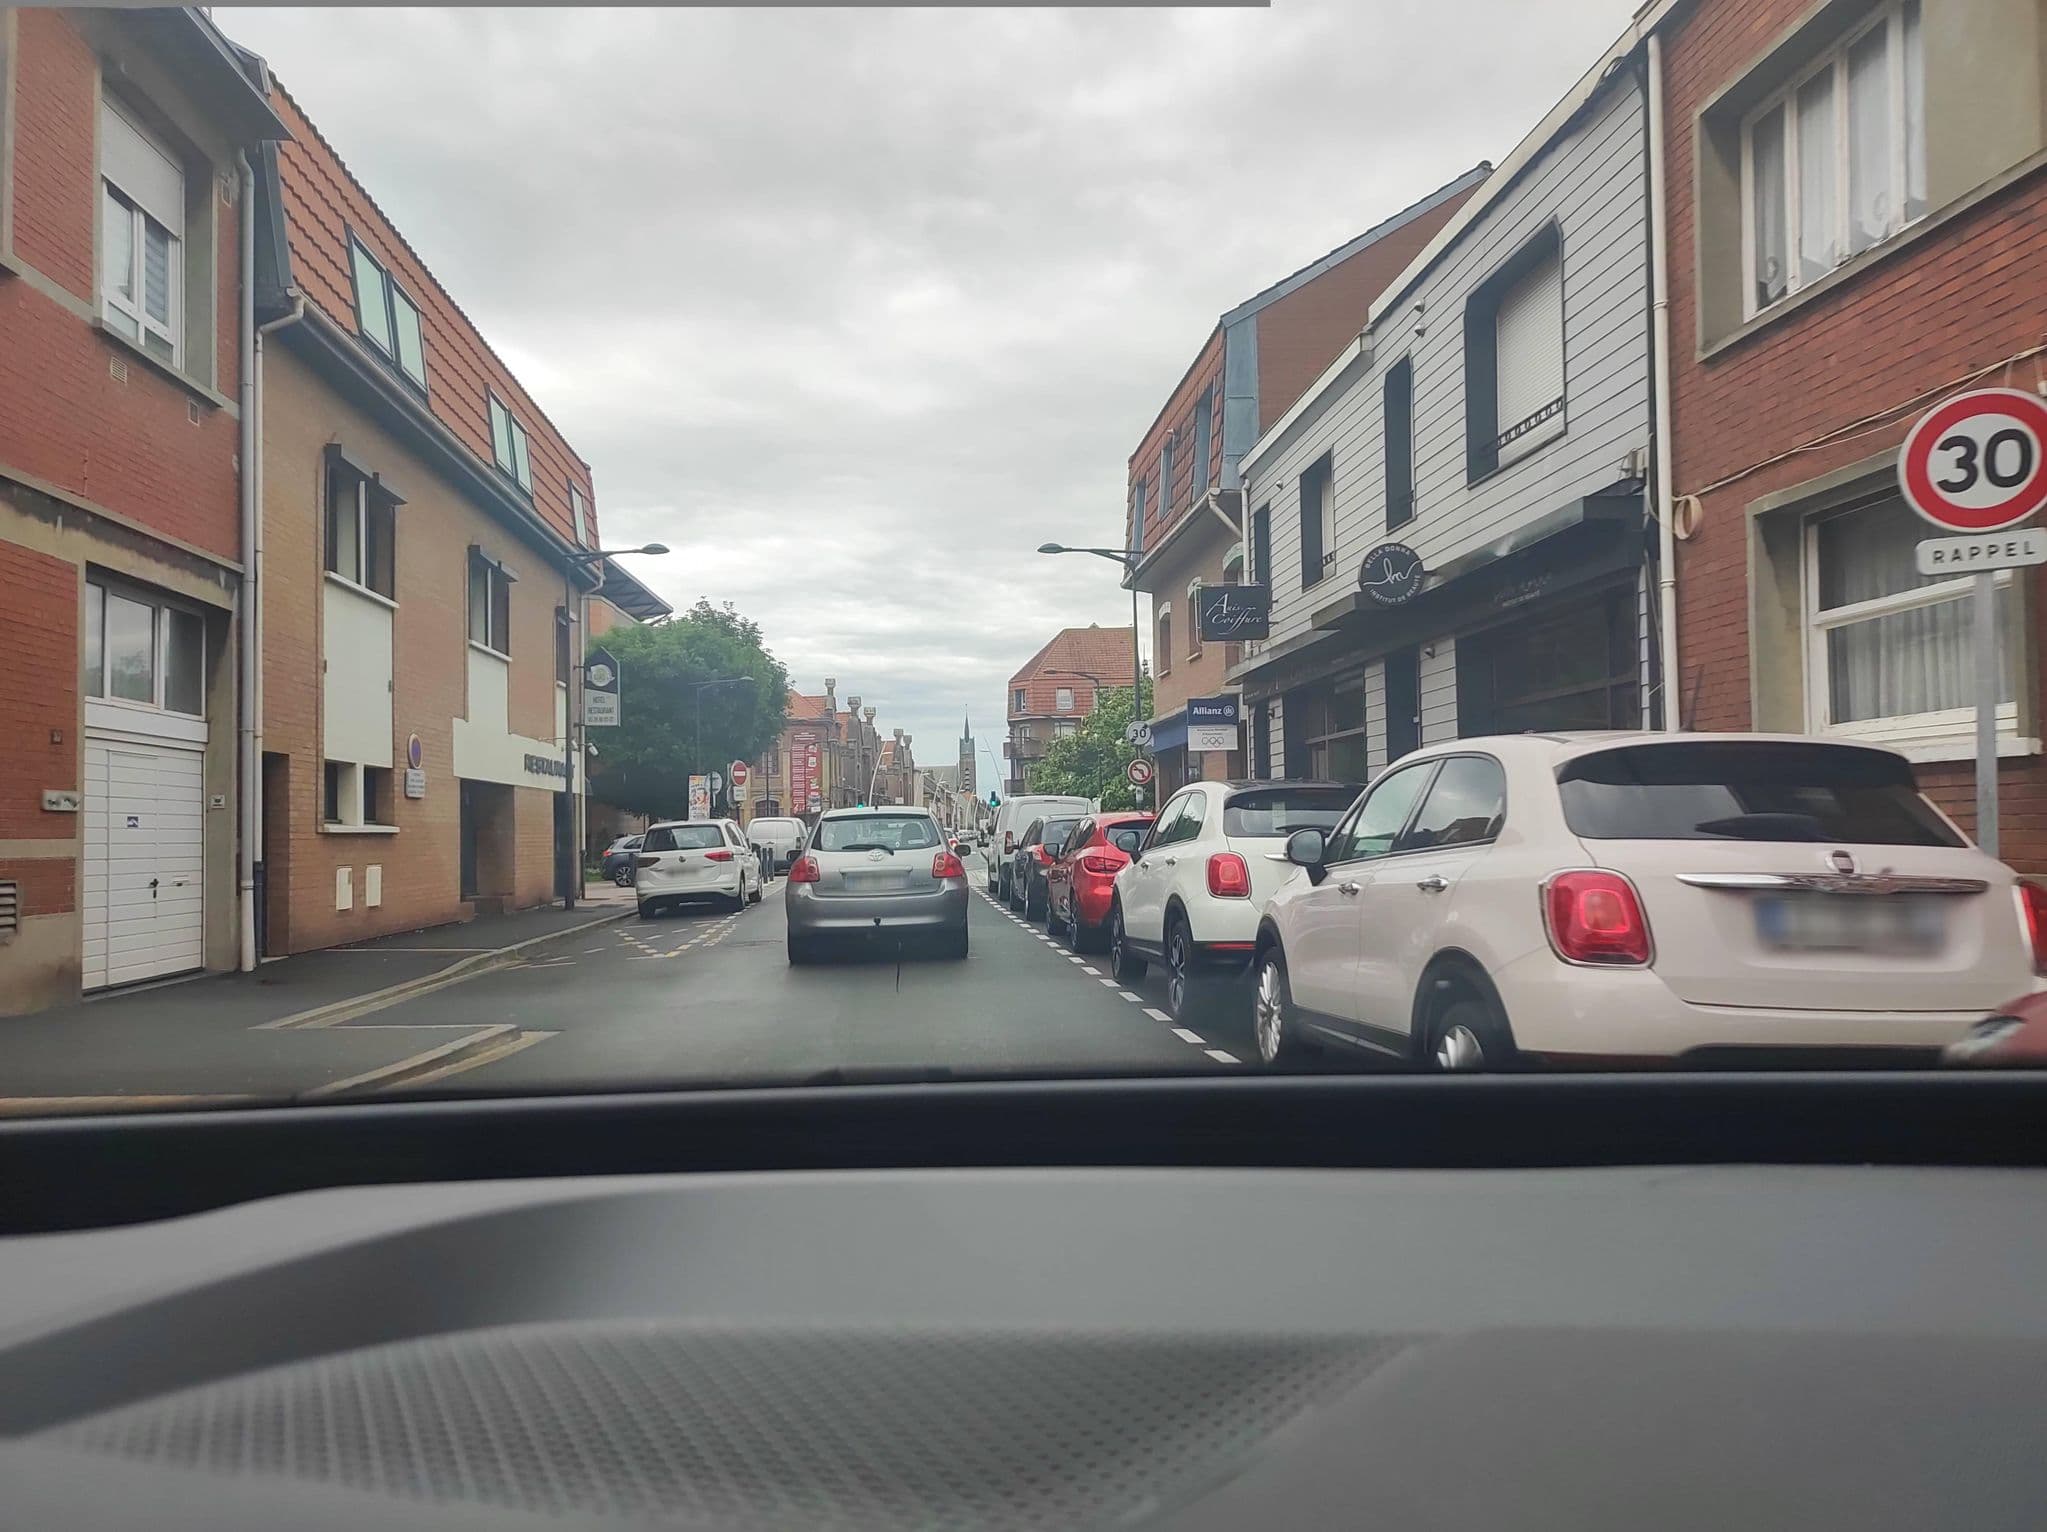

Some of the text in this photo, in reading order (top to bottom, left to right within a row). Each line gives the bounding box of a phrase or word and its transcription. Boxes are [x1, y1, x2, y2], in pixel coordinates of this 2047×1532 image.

[1936, 428, 2033, 494] 30
[1364, 545, 1411, 569] BELLA DONNA
[1932, 540, 2036, 565] RAPPEL
[1369, 588, 1397, 604] INSTITUT
[1211, 607, 1263, 636] Coiffure
[1192, 706, 1223, 715] Allianz
[1132, 727, 1147, 739] 30
[524, 753, 575, 778] RESTAURA
